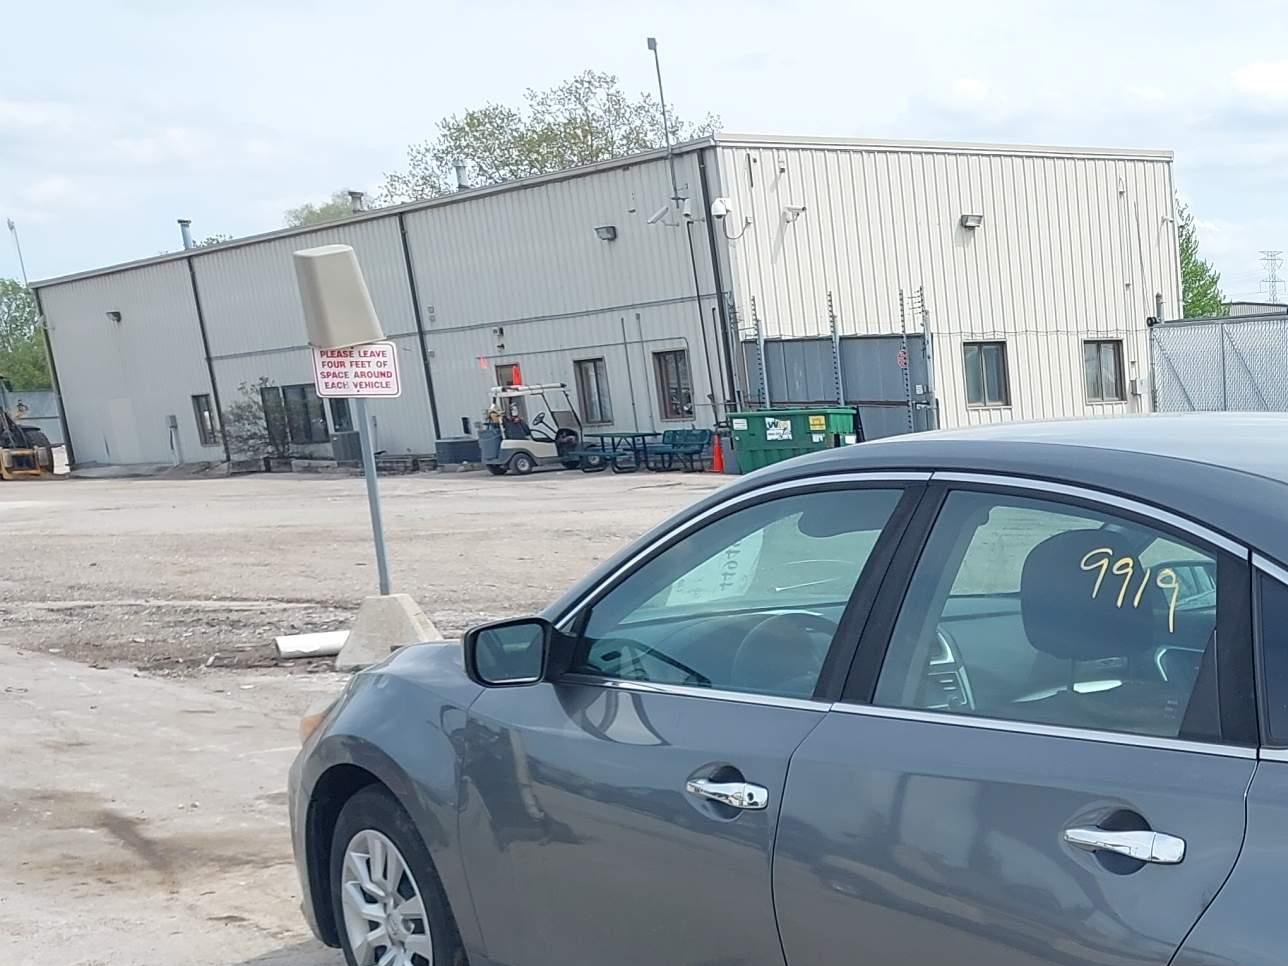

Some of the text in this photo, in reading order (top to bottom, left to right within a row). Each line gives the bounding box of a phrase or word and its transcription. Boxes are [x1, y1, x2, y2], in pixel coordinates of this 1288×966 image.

[320, 350, 387, 358] PLEASE LEAVE
[321, 361, 346, 369] FOUR
[320, 371, 393, 379] SPACE AROUND
[324, 381, 391, 390] EACH VEHICLE
[1080, 548, 1179, 633] 9919
